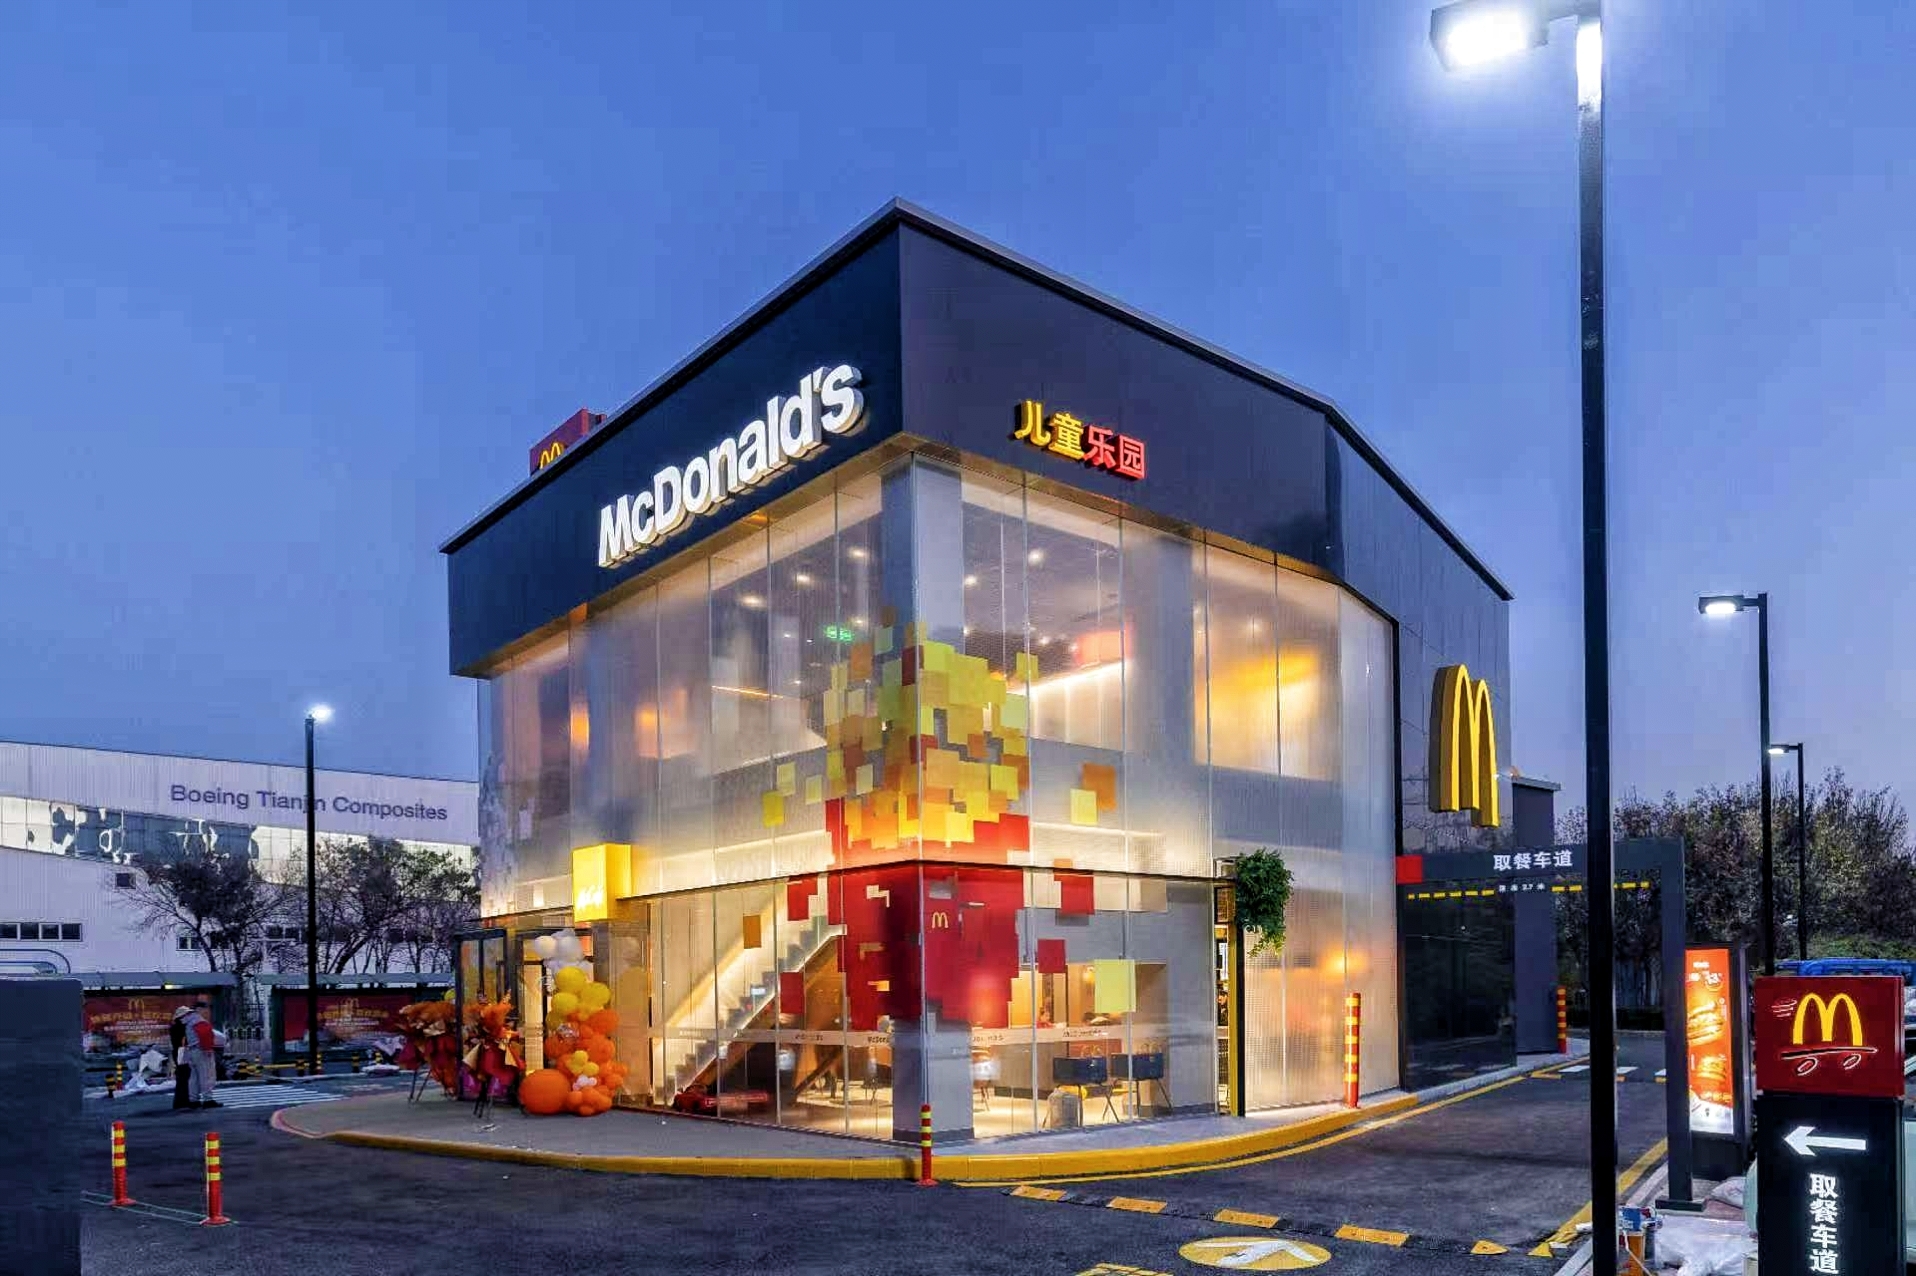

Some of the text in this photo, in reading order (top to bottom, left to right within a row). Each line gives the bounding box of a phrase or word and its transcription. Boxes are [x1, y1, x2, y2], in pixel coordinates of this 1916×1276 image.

[599, 364, 863, 568] McDonald's
[1014, 400, 1145, 479] 儿童乐园
[170, 784, 448, 820] Boeing Tianjn Composites
[1493, 851, 1574, 871] 取餐车道
[1809, 1173, 1839, 1275] 取餐车道
